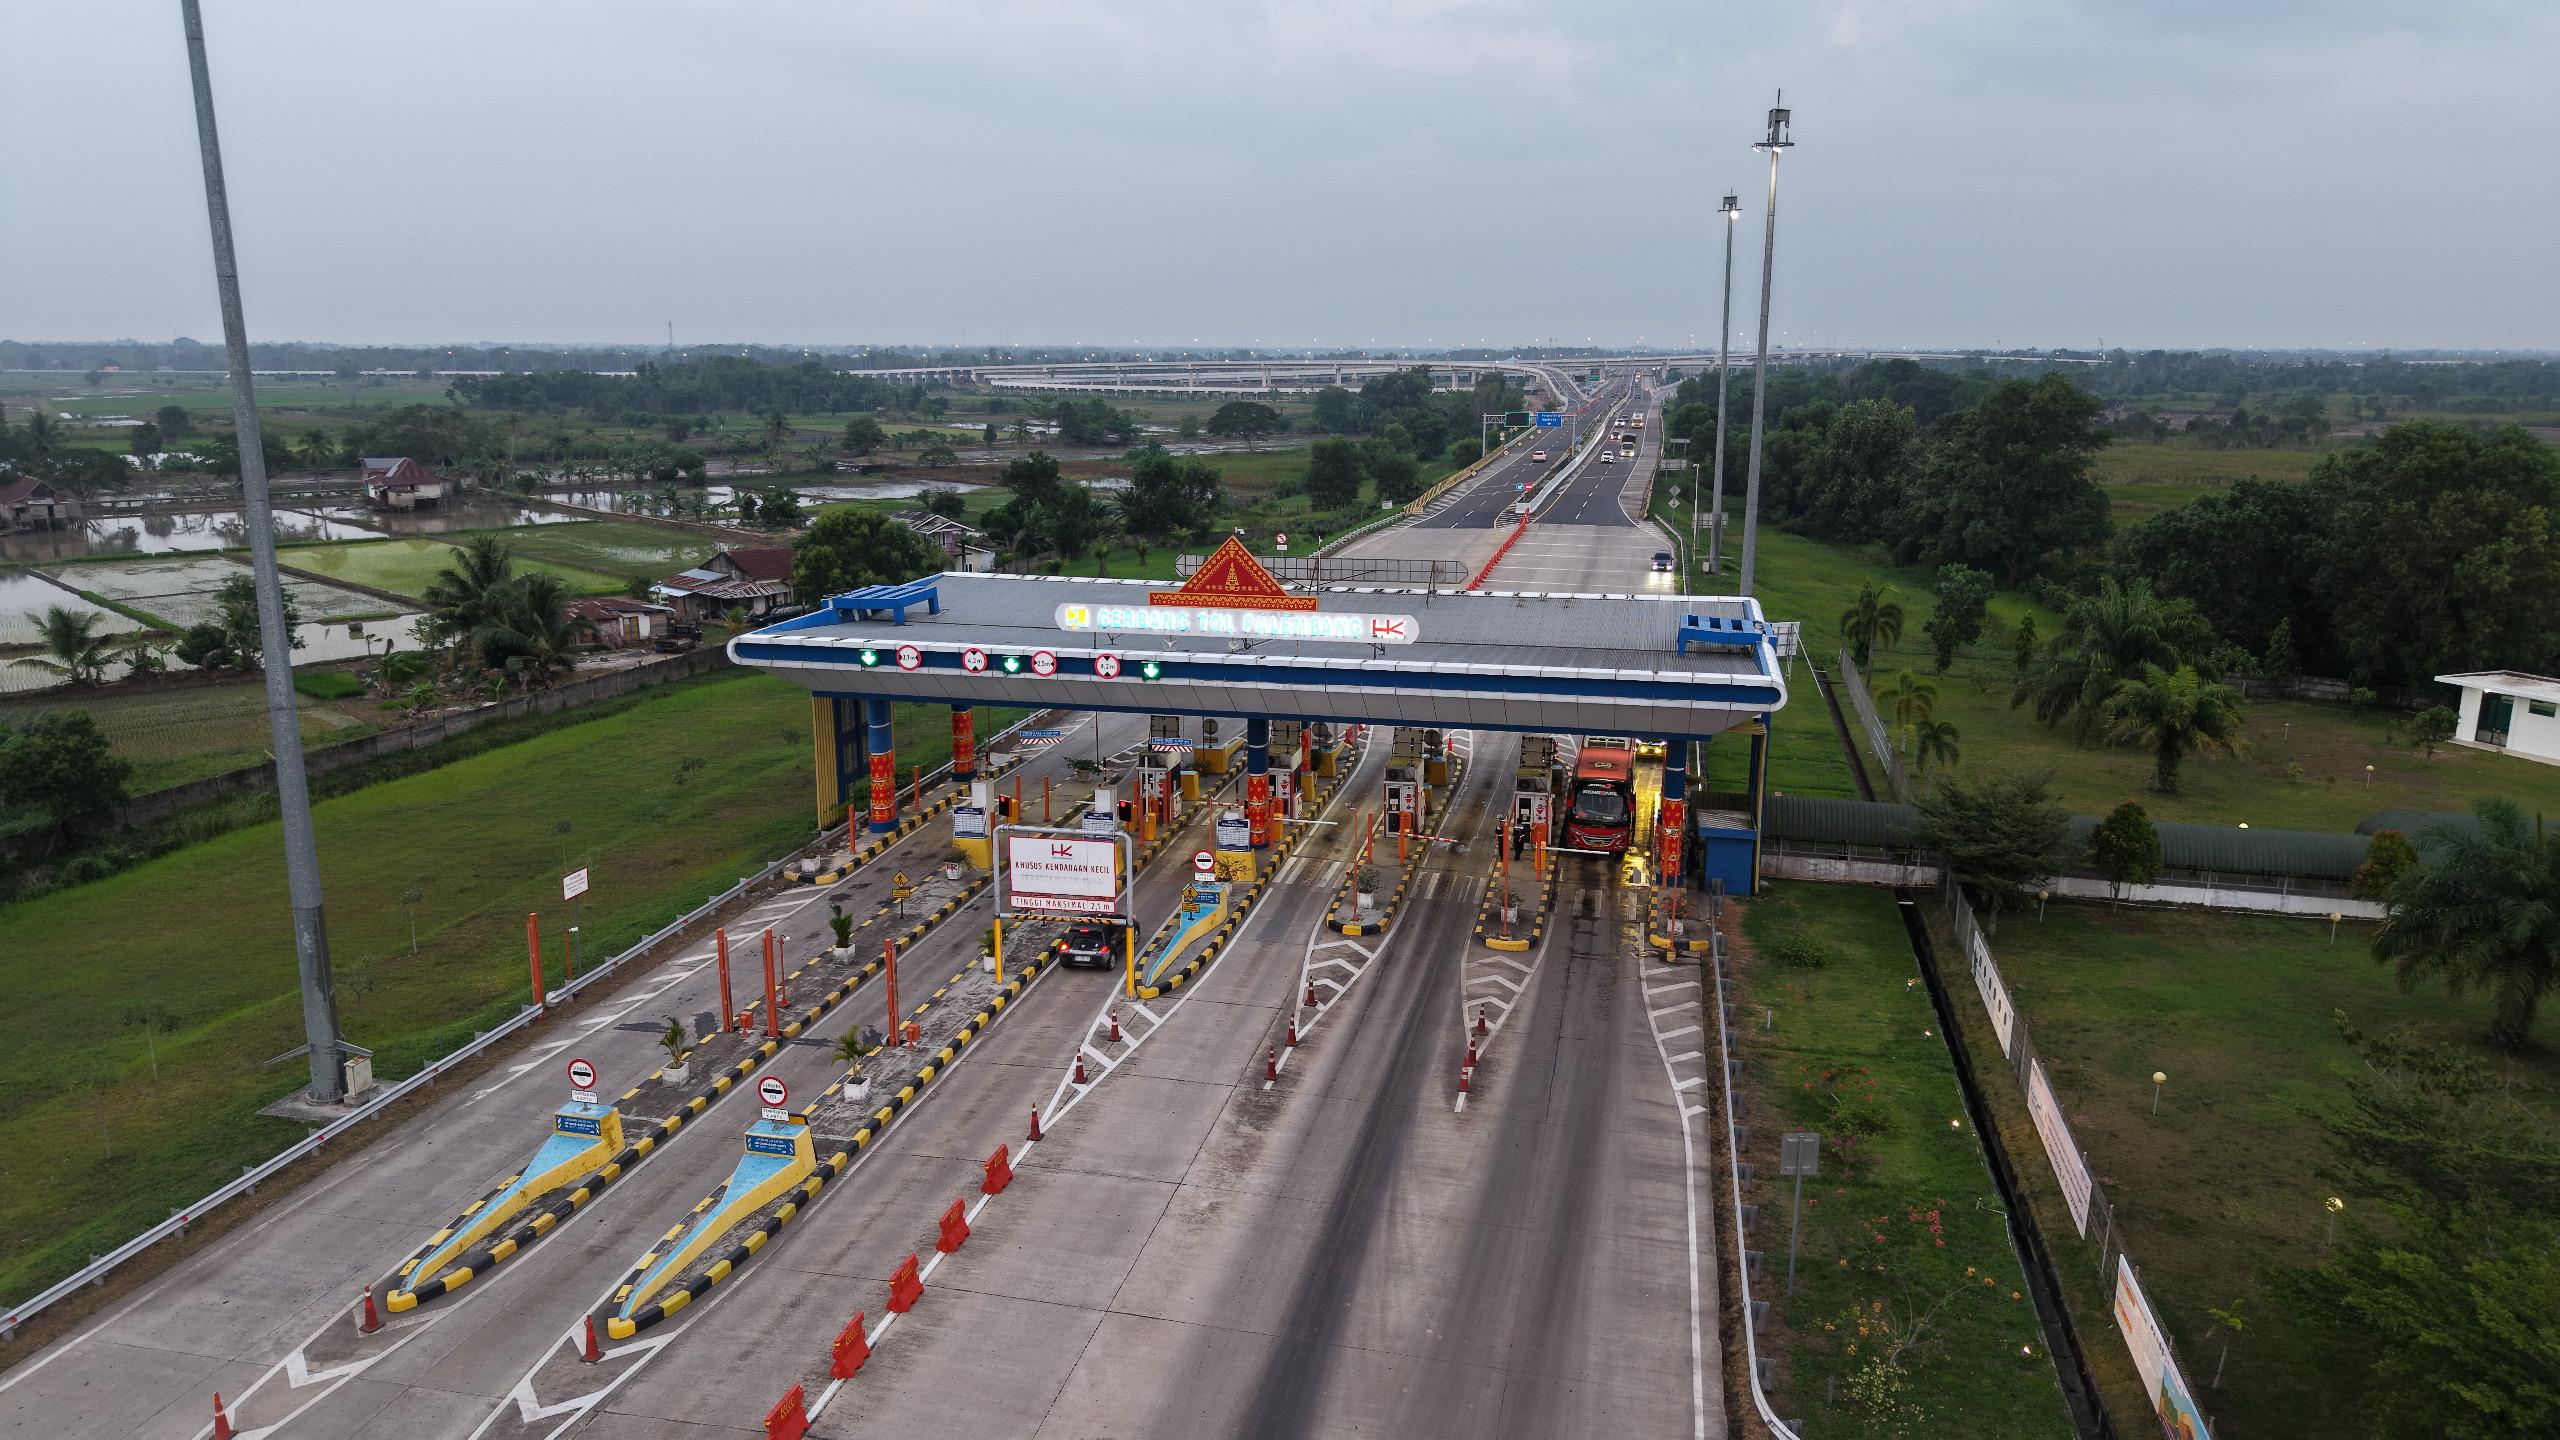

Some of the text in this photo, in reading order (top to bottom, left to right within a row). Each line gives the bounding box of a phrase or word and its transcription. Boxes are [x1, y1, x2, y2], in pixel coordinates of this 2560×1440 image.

[1098, 608, 1363, 639] GERBANG TOL PALEMBANG
[1051, 843, 1073, 857] HK
[1015, 861, 1110, 874] KHUSUS KENDARAAN KECIL
[1016, 897, 1042, 907] TINGGI
[1046, 900, 1087, 910] MAKSIMAL
